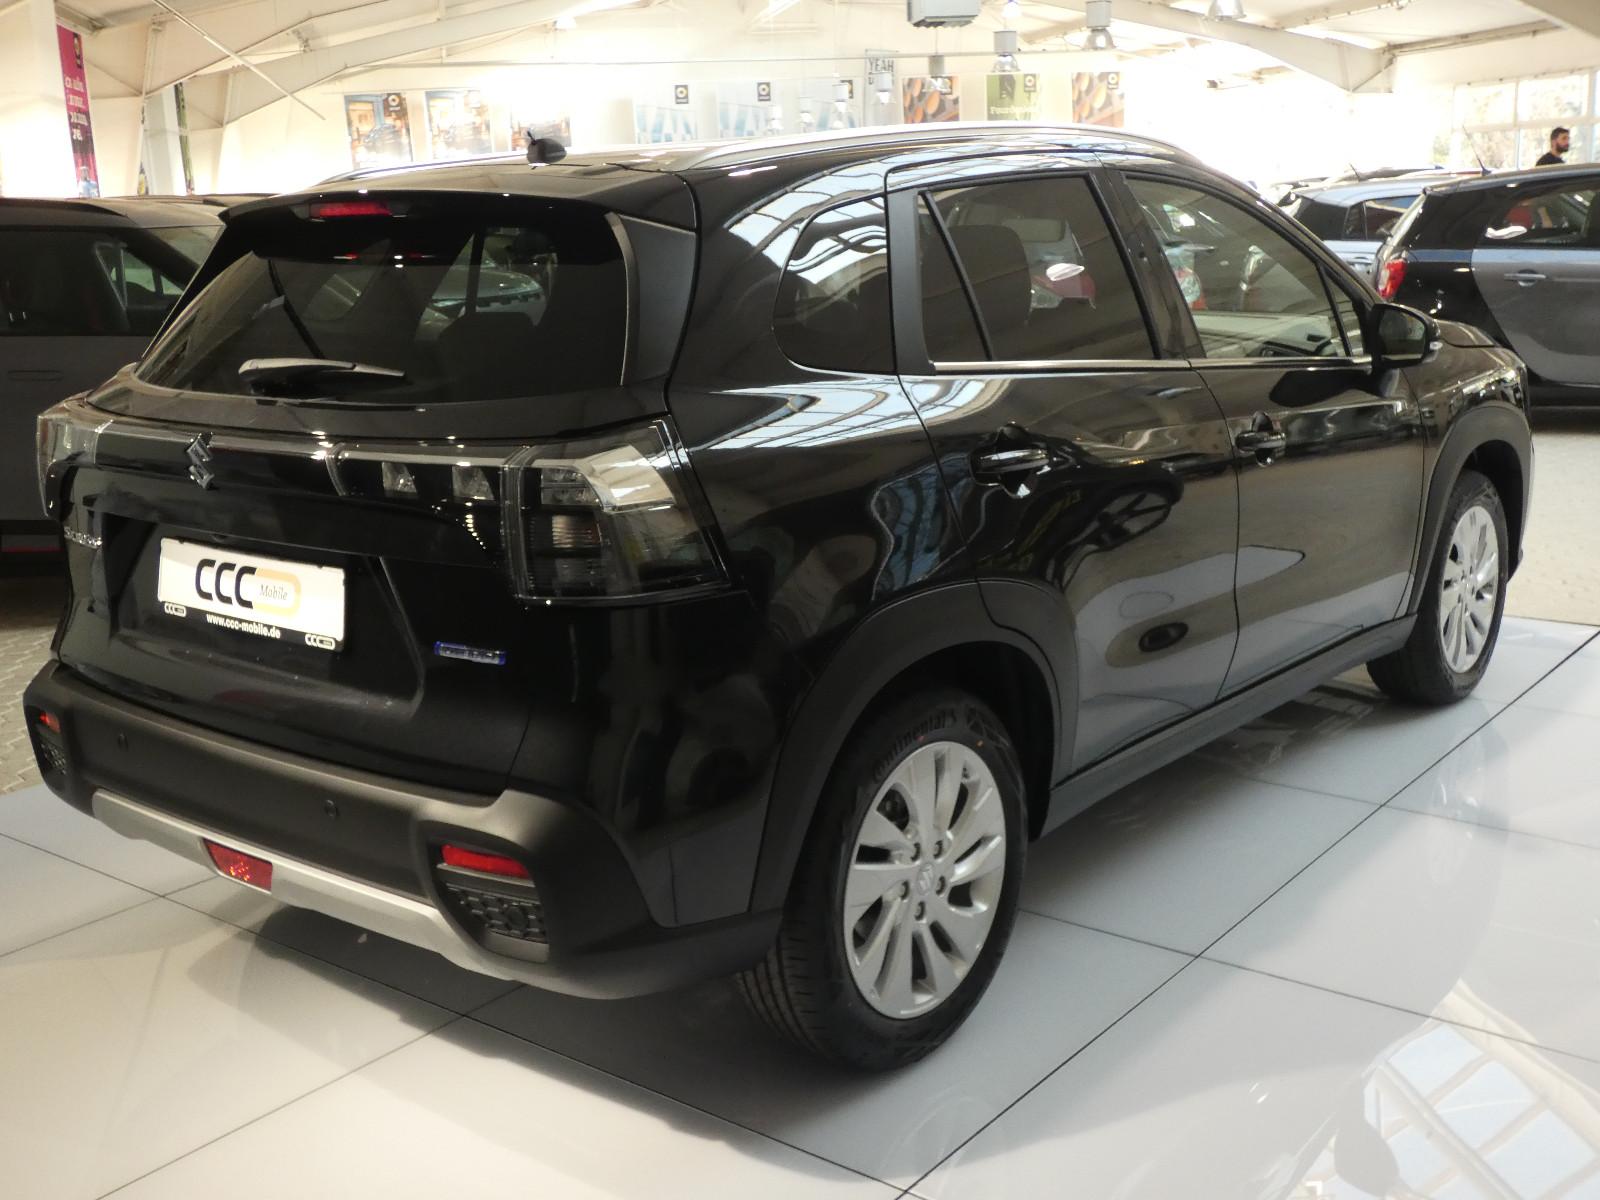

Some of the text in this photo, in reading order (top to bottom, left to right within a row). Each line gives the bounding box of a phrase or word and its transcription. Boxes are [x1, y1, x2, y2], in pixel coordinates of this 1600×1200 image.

[868, 57, 894, 72] YEAH
[195, 558, 257, 609] CCC
[260, 584, 288, 600] Mobile
[206, 613, 281, 639] www.ccc-mobile.de
